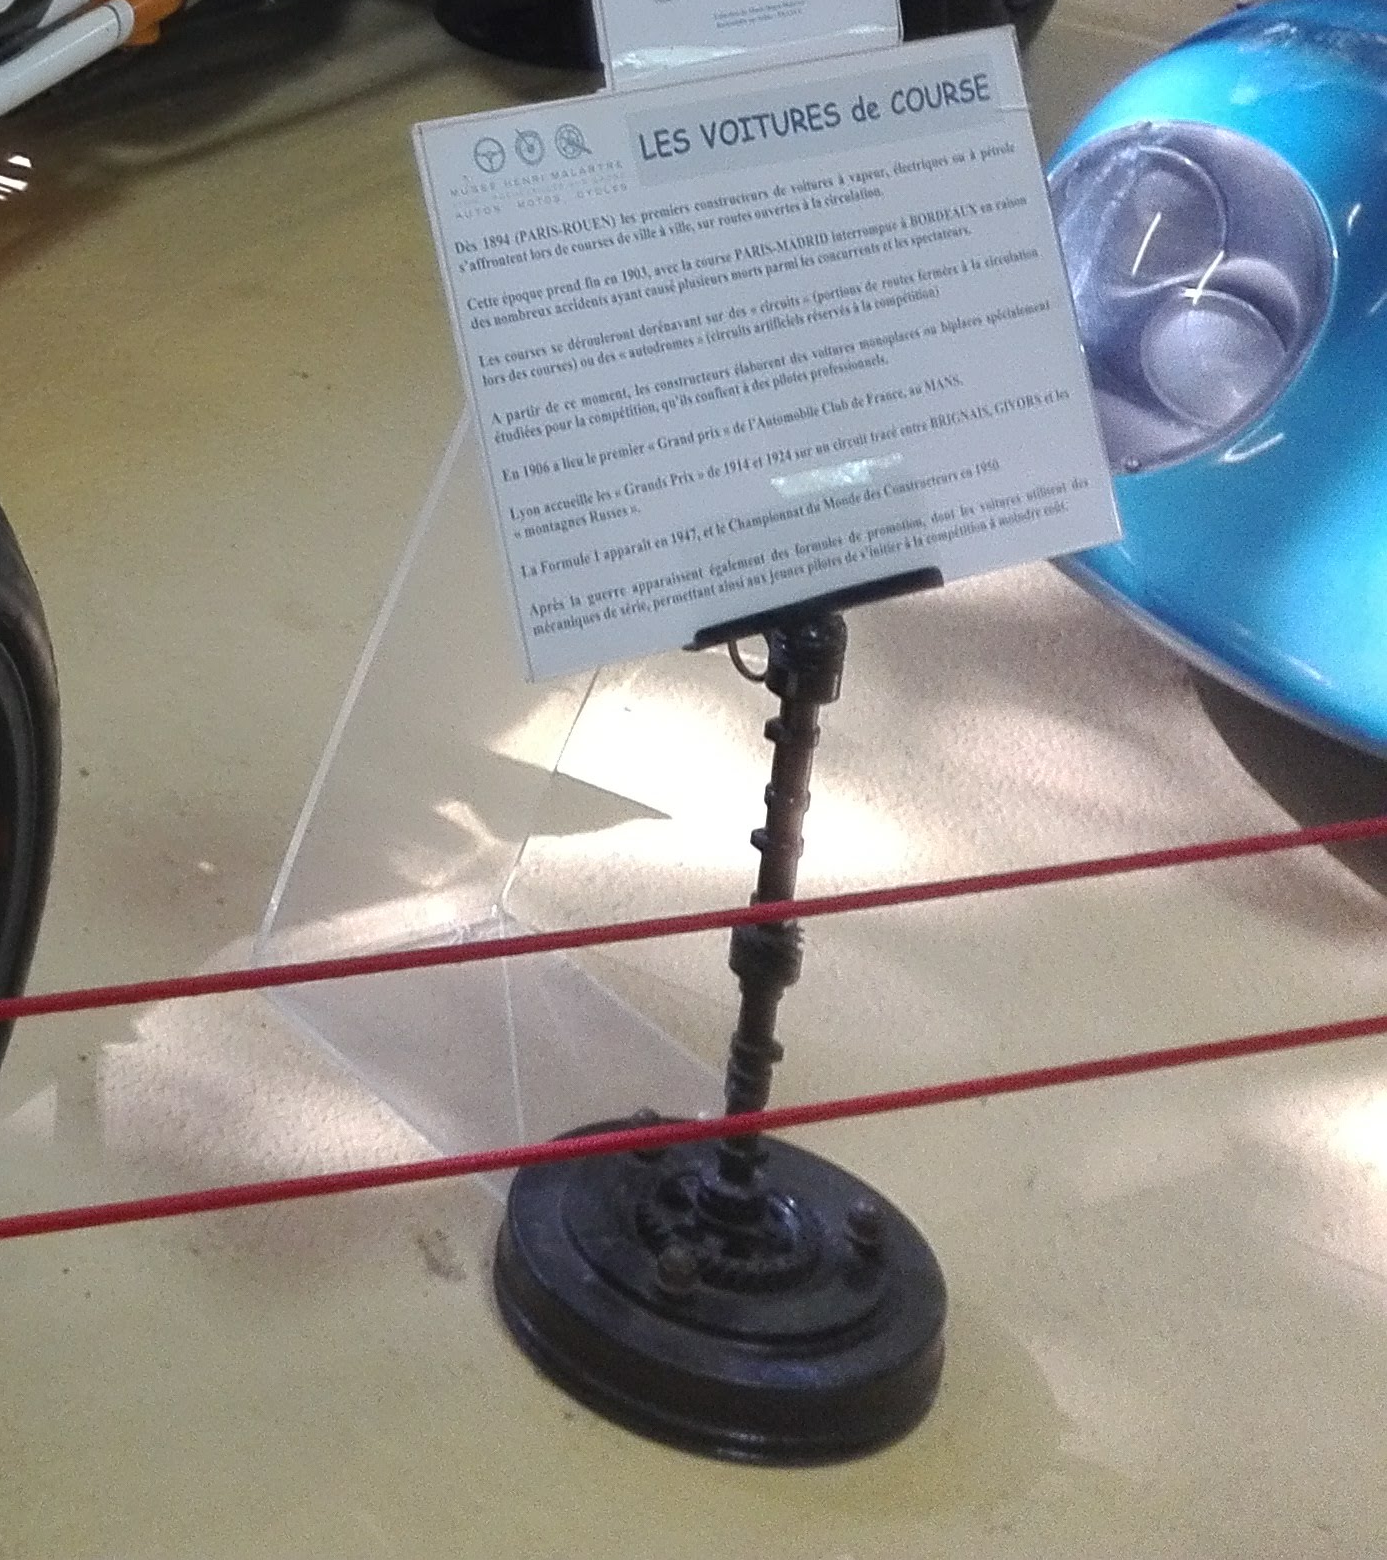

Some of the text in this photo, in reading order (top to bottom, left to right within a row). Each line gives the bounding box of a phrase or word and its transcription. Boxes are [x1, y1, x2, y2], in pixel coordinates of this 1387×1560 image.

[637, 73, 991, 161] LES VOITURES de COURSE
[454, 239, 477, 255] Dès
[482, 232, 510, 250] 1894
[513, 213, 616, 246] (PARIS-ROUEN)
[619, 211, 636, 225] les
[640, 202, 690, 224] premiers
[693, 188, 768, 211] constructeurs
[790, 176, 833, 193] voitures
[458, 202, 800, 274] s'affrontent lors de courses de ville à ville, sur routes ouvertes
[466, 296, 499, 312] Cette
[501, 288, 544, 307] époque
[546, 277, 581, 300] prend
[583, 275, 601, 289] fin
[603, 274, 618, 286] en
[653, 262, 679, 276] avec
[680, 257, 692, 271] la
[694, 252, 732, 268] course
[734, 230, 829, 260] PARIS-MADRID
[469, 316, 491, 331] des
[493, 306, 552, 326] nombreux
[554, 294, 608, 314] accidents
[610, 286, 642, 305] ayant
[644, 279, 676, 297] causé
[677, 271, 729, 293] plusieurs
[730, 264, 763, 280] morts
[764, 254, 798, 276] parmi
[799, 253, 815, 267] les
[816, 241, 880, 263] concurrents
[478, 354, 500, 369] Les
[504, 346, 547, 364] courses
[551, 343, 564, 354] se
[566, 327, 634, 351] dérouleront
[637, 314, 702, 337] dorénavant
[705, 311, 724, 324] sur
[726, 305, 747, 319] des
[759, 294, 800, 313] circuits
[481, 373, 506, 388] lors
[507, 368, 527, 382] des
[529, 356, 578, 378] courses)
[579, 356, 595, 368] ou
[596, 350, 616, 365] des
[627, 336, 694, 358] autodromes
[704, 323, 751, 344] (circuits
[753, 311, 804, 333] artificiels
[493, 377, 770, 445] étudiées pour la compétition, qu'ils confient à des
[505, 404, 541, 426] partir
[544, 400, 560, 415] de
[563, 399, 577, 411] ce
[580, 387, 631, 408] moment,
[634, 382, 650, 396] les
[653, 368, 730, 392] constructeurs
[788, 350, 808, 364] des
[811, 342, 855, 360] voitures
[501, 396, 849, 483] En 1906 a lieu le premier Grand prix l'Automobile Club
[509, 505, 540, 522] Lyon
[543, 491, 594, 514] accueille
[595, 488, 611, 502] les
[622, 475, 667, 496] Grands
[669, 469, 694, 486] Prix
[705, 463, 721, 478] de
[723, 456, 750, 474] 1914
[794, 446, 812, 458] sur
[831, 431, 867, 450] circuit
[520, 487, 881, 579] La Formule 1 en 1947, et le Championnat Monde des
[524, 505, 627, 538] montagnes Russes
